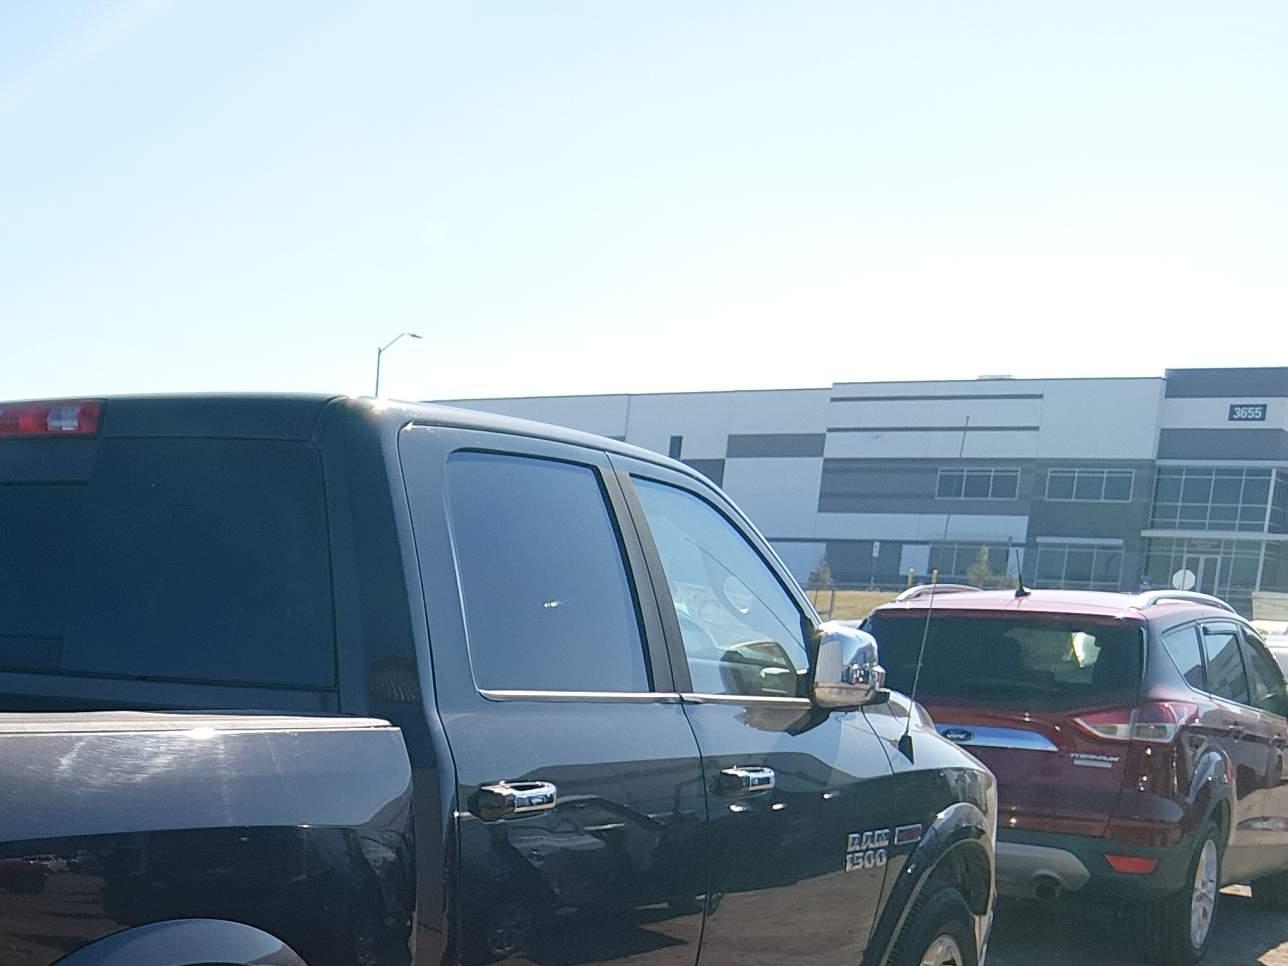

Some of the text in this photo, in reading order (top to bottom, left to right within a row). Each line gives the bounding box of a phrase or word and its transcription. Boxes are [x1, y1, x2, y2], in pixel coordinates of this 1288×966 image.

[1233, 407, 1263, 418] 3655
[847, 829, 889, 852] RAM
[846, 849, 887, 872] 1500
